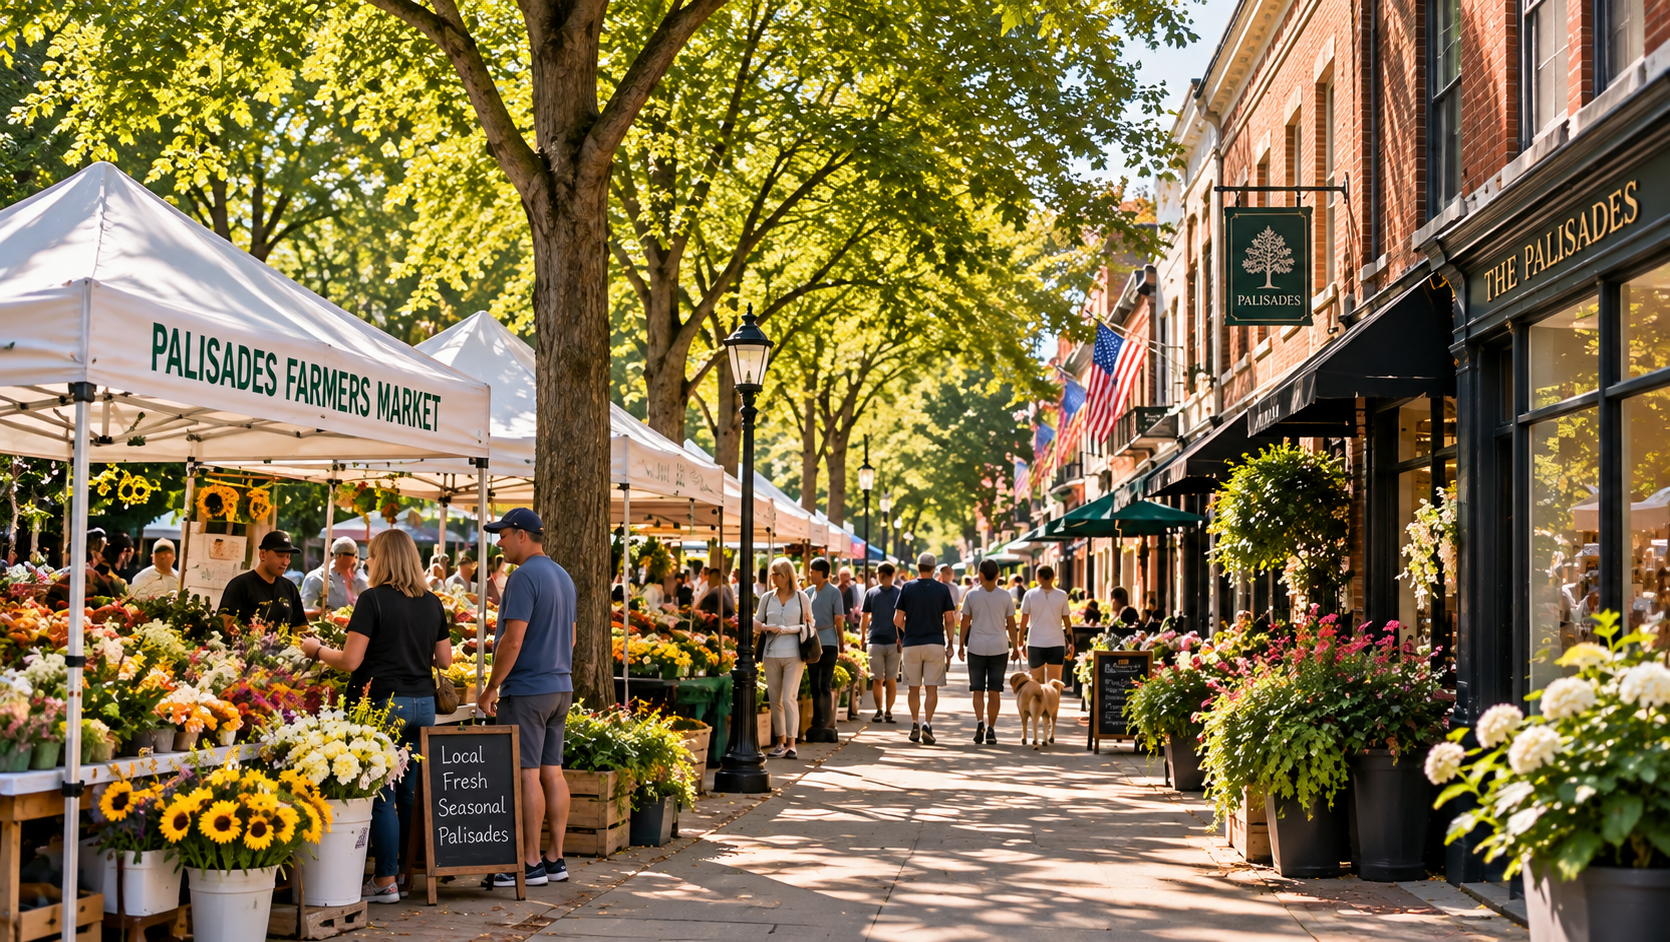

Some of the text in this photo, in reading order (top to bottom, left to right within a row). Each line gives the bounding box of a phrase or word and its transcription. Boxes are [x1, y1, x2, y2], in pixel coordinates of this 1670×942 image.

[1484, 180, 1640, 302] THE PALISADES
[1237, 294, 1302, 307] PALISADES
[151, 321, 442, 433] PALISADES FARMERS MARKET
[441, 744, 486, 765] Local
[442, 771, 488, 791] Fresh
[438, 795, 507, 817] Seasonal
[438, 824, 509, 846] Palisades
